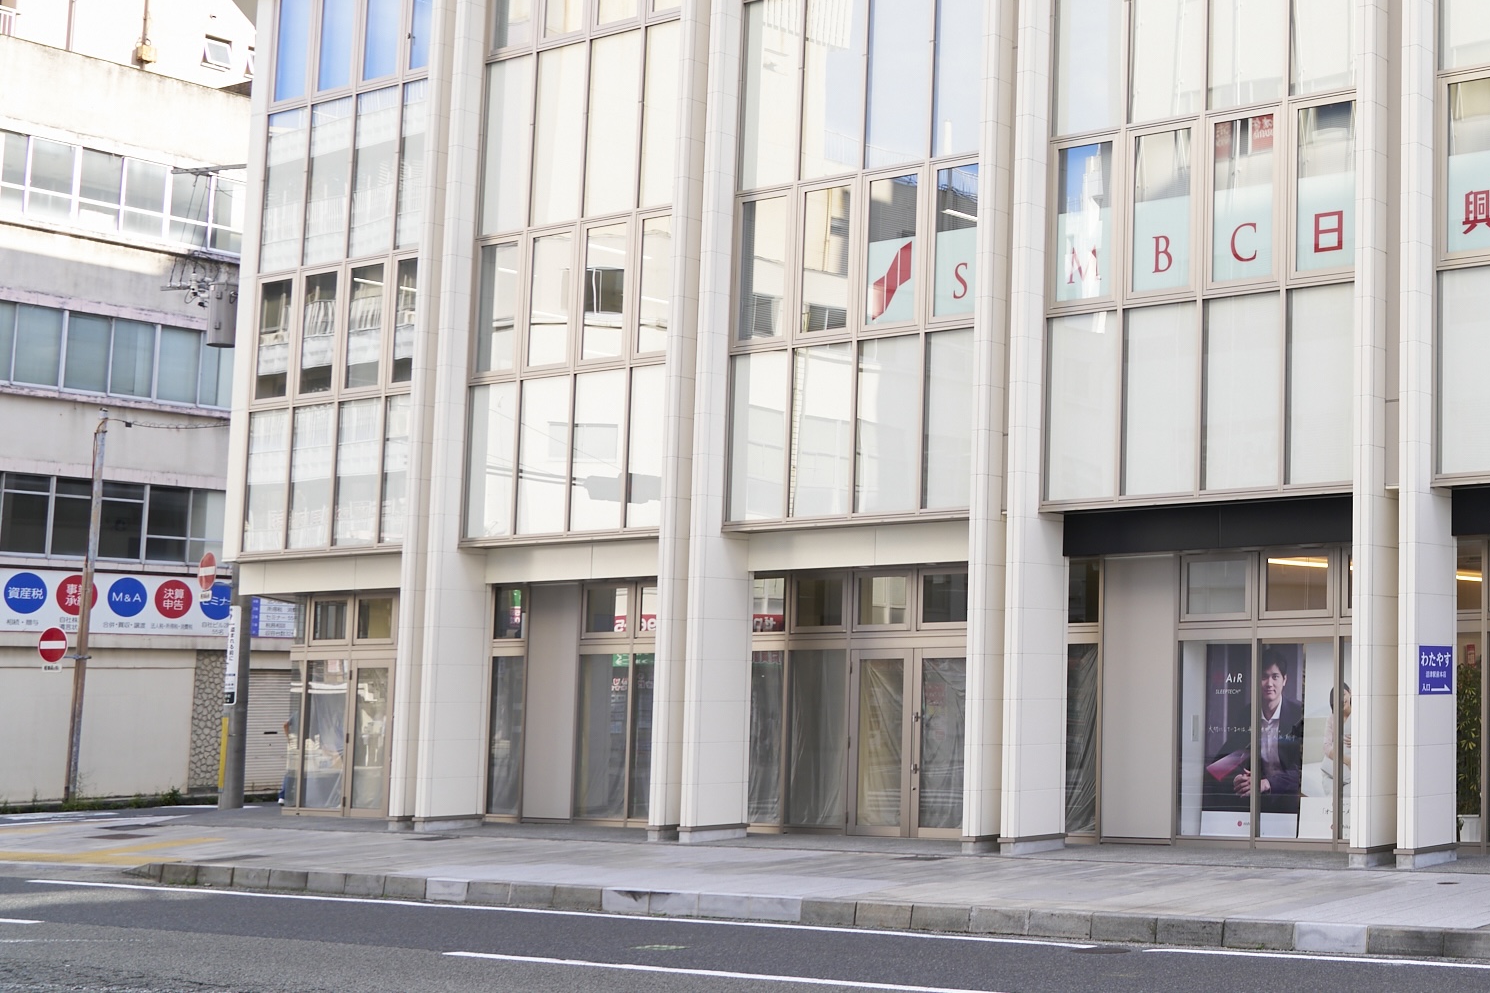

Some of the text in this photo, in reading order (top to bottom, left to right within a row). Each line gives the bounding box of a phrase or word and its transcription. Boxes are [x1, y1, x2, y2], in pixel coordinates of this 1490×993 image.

[8, 587, 44, 599] 資産税
[164, 588, 184, 599] 決算
[163, 600, 184, 610] 申告
[1421, 651, 1452, 667] わたやす
[1422, 683, 1431, 692] 入口
